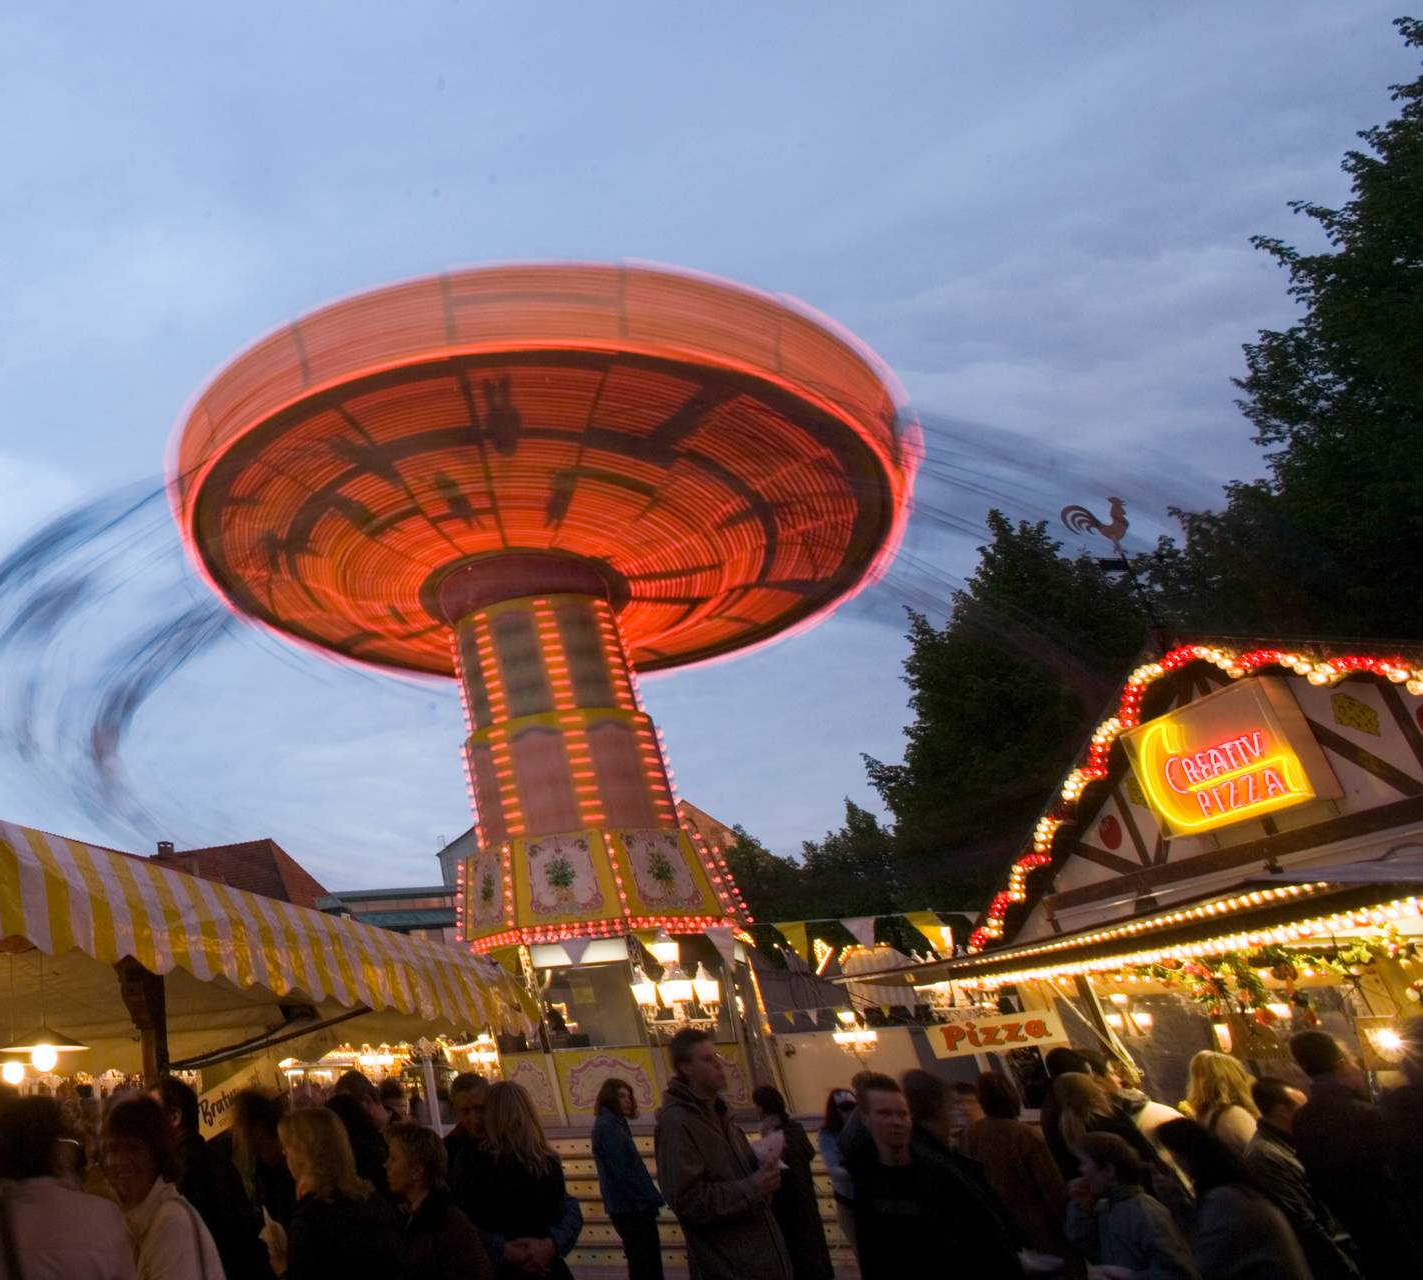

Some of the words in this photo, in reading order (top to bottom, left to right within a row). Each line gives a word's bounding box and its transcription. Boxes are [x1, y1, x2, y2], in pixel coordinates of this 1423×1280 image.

[1165, 730, 1263, 795] CREATIV
[1196, 768, 1288, 818] PIZZA
[939, 1018, 1053, 1052] Pizza
